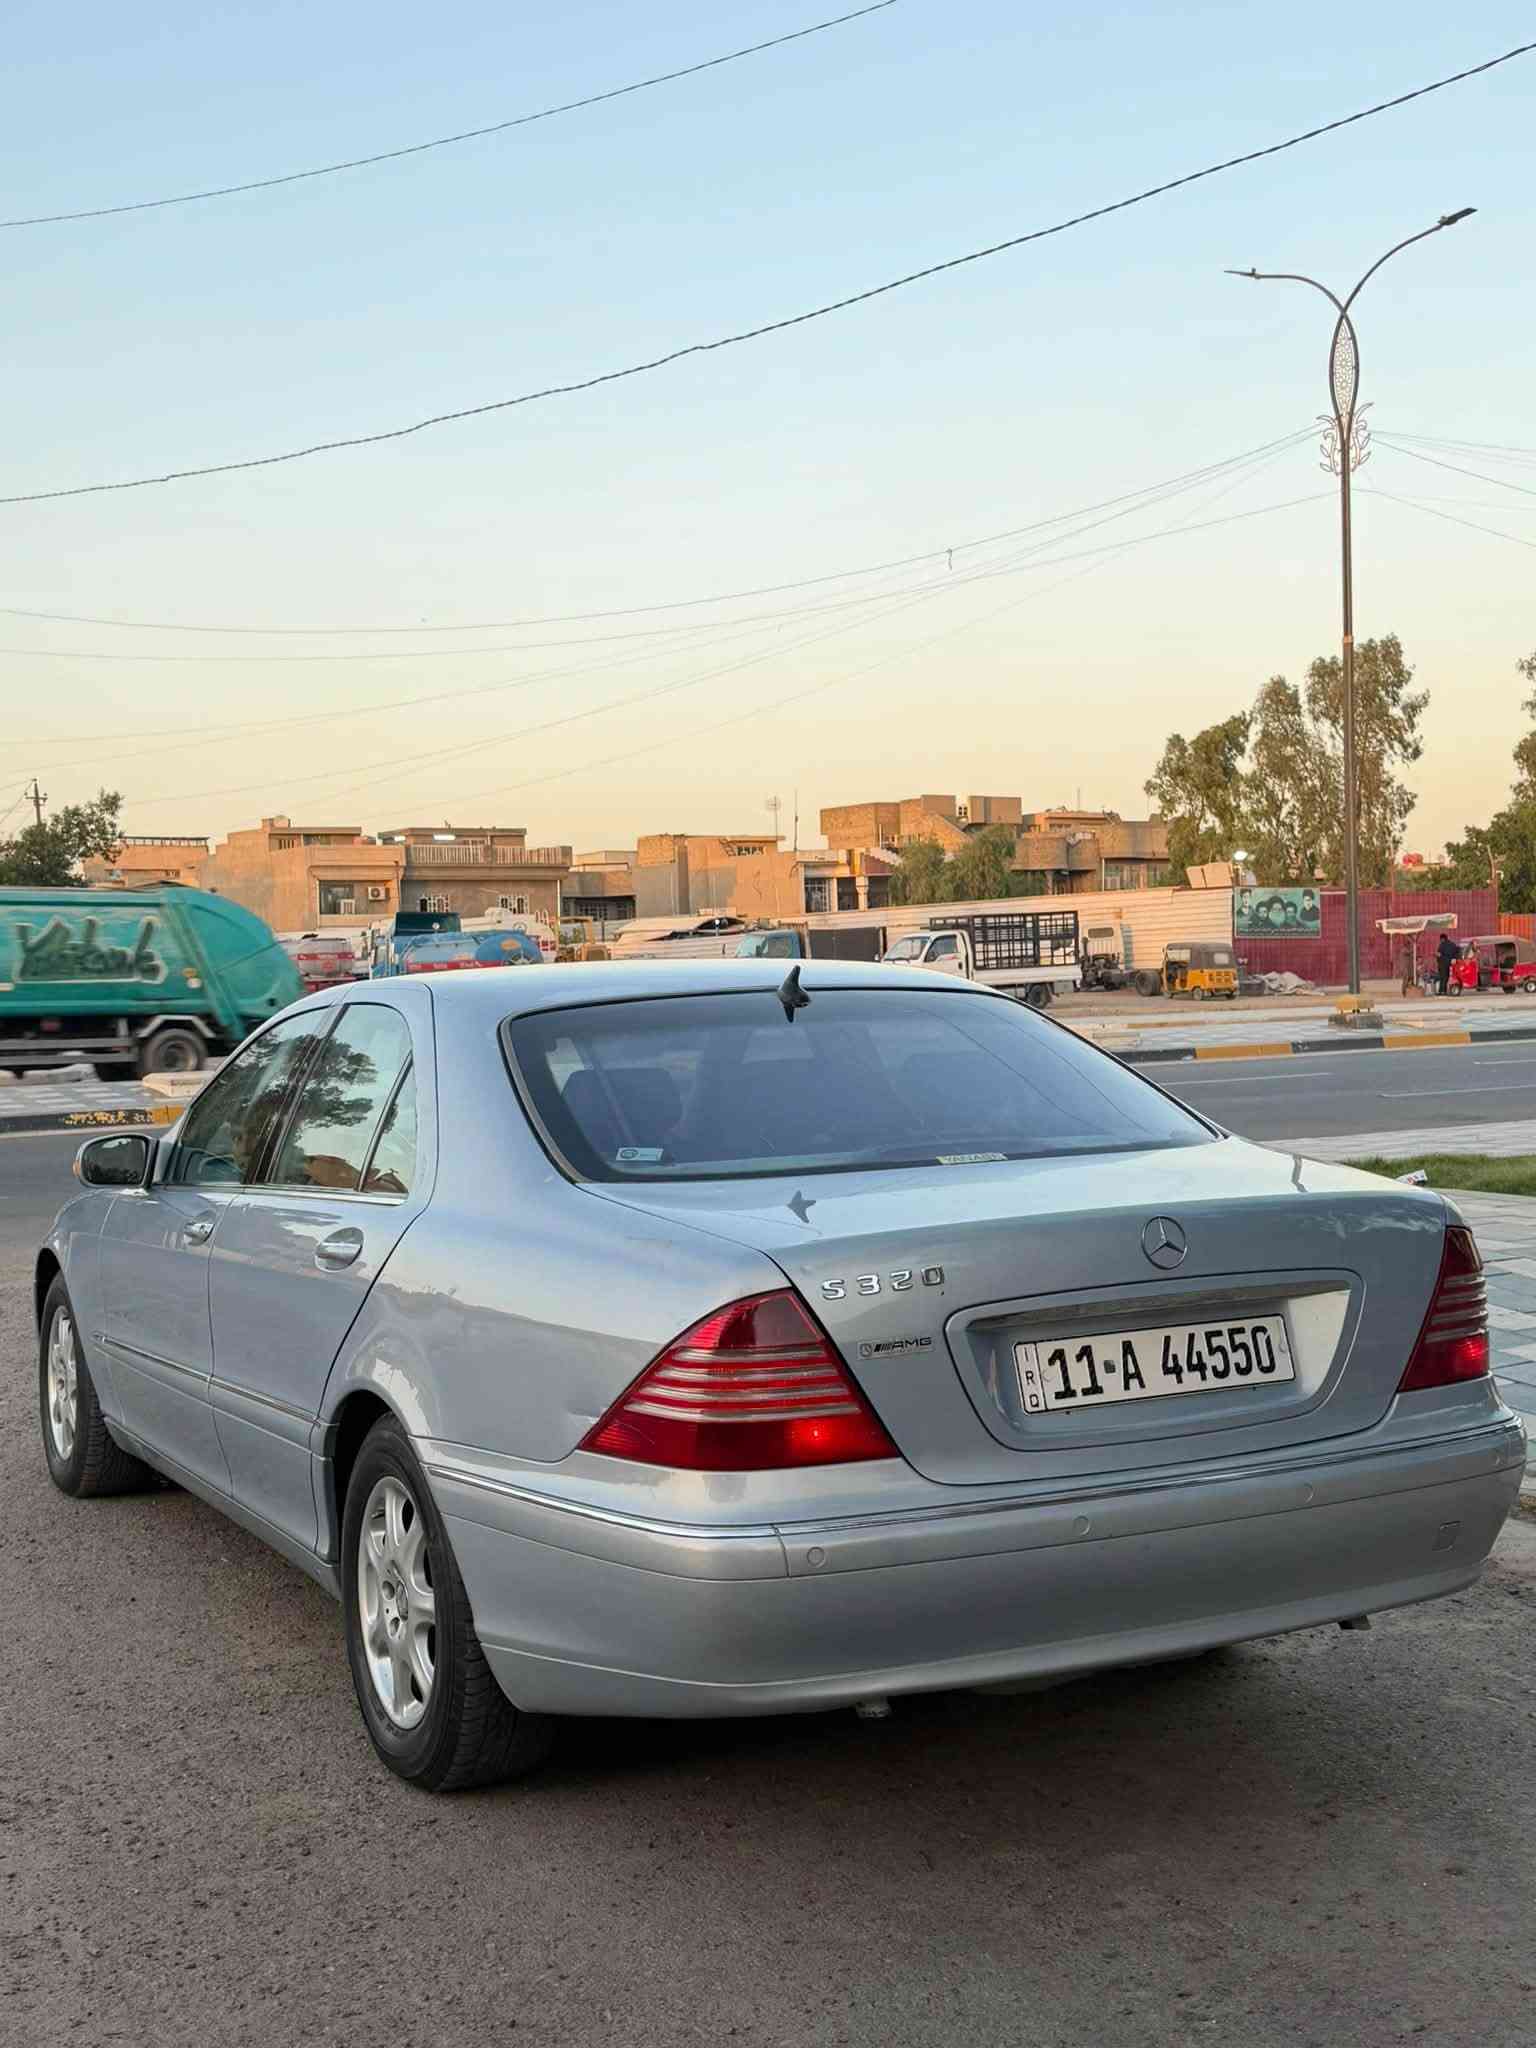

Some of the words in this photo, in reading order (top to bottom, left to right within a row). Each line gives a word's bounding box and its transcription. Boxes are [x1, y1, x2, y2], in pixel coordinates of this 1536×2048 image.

[892, 1337, 932, 1350] AMG
[1047, 1344, 1104, 1400] 11
[1121, 1340, 1146, 1391] A
[1161, 1325, 1277, 1384] 44550
